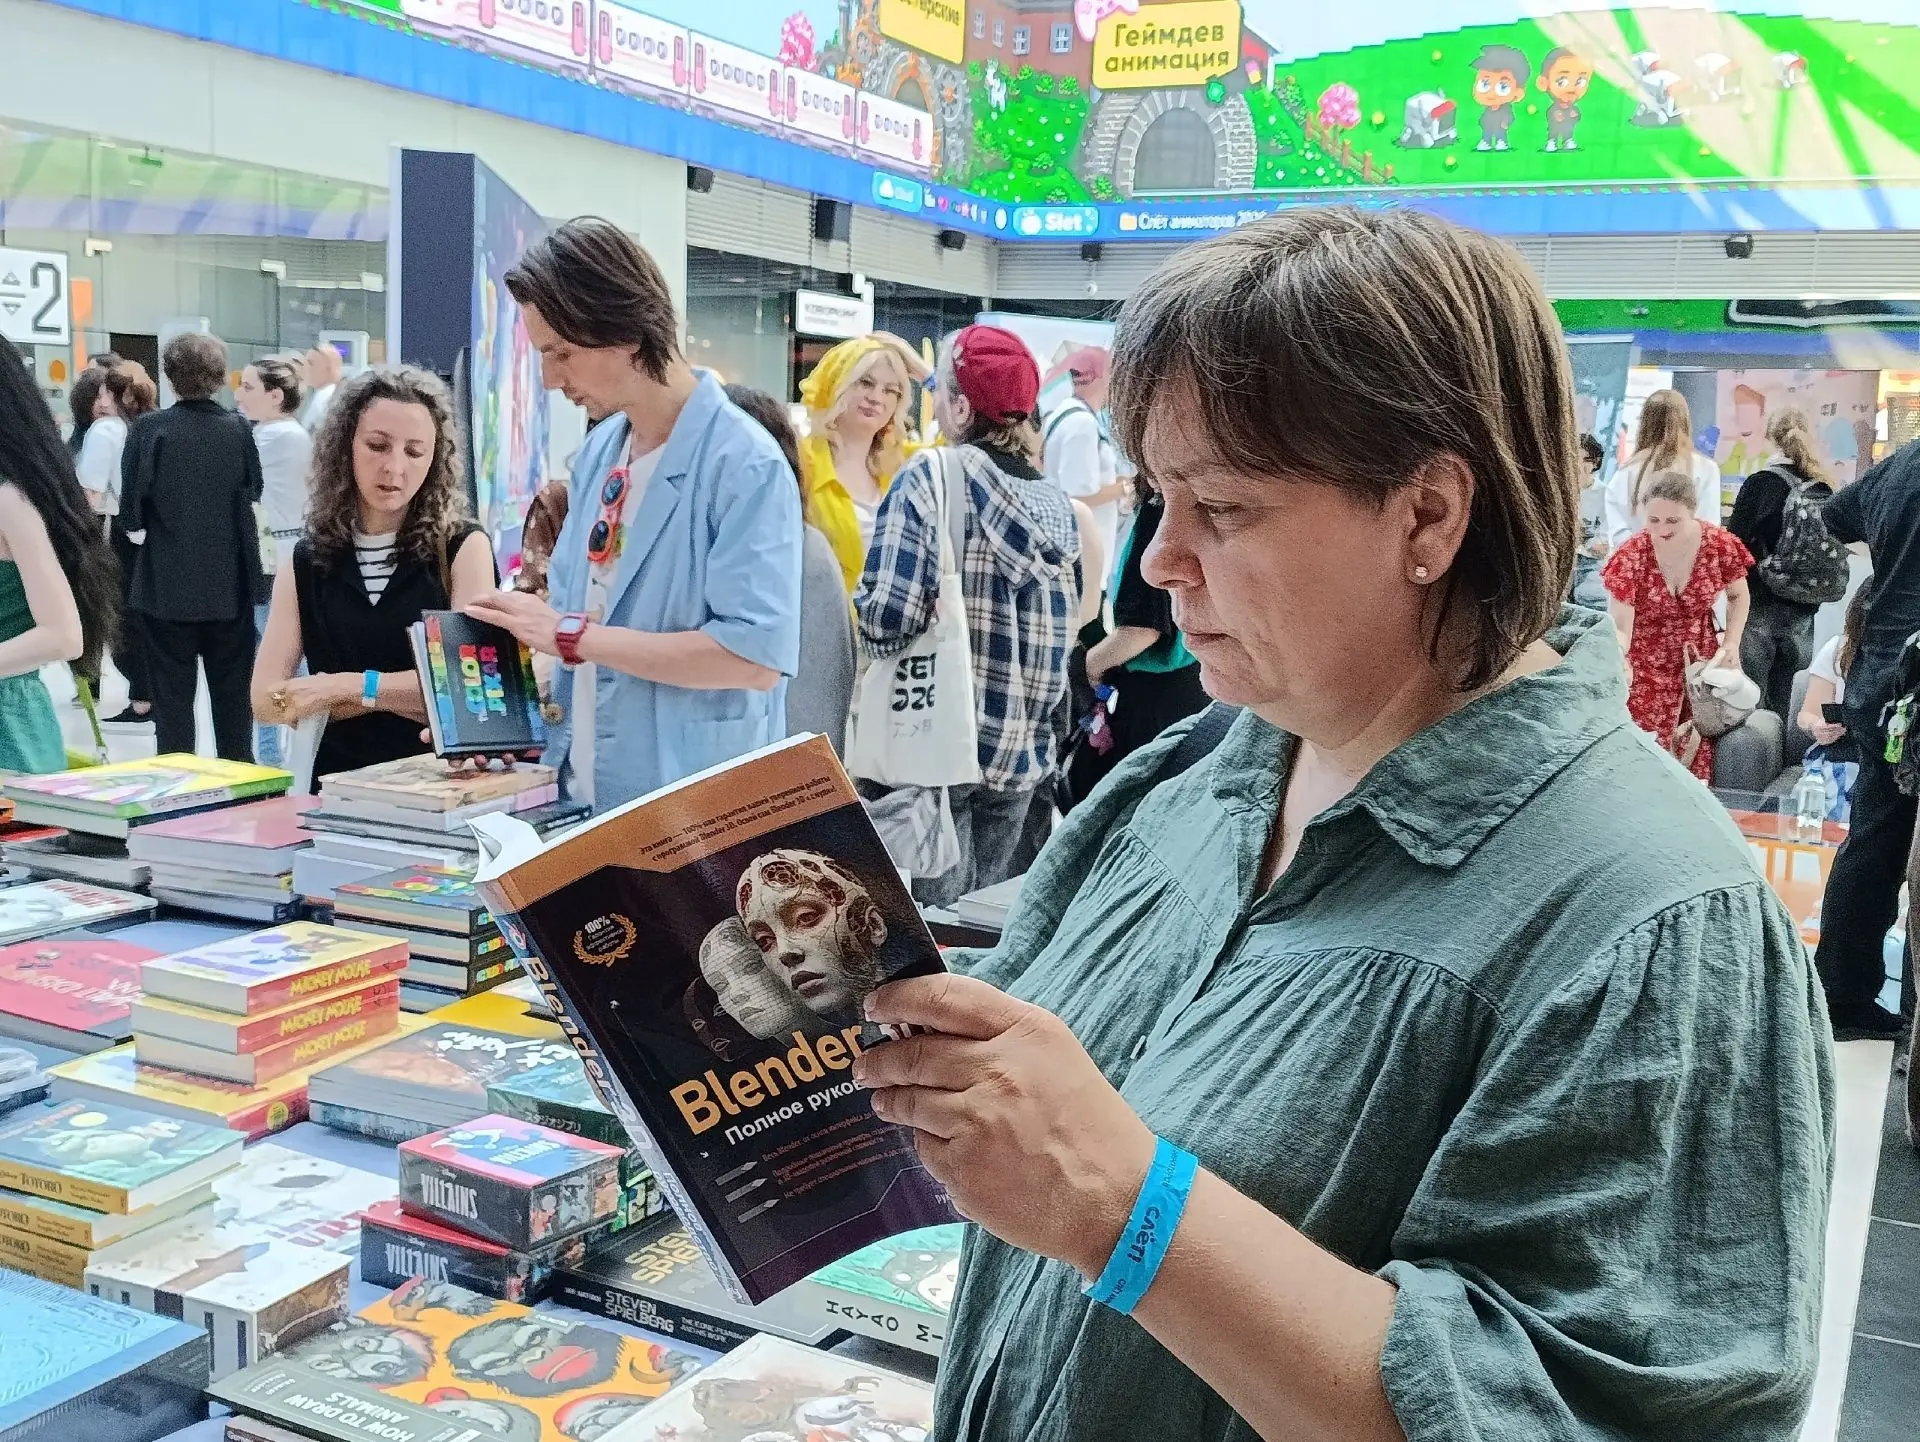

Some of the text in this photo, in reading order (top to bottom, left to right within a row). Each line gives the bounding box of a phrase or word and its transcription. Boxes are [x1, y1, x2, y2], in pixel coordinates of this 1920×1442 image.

[1114, 22, 1226, 49] Геймдев
[1103, 50, 1231, 74] анимация
[1044, 210, 1083, 232] Slet
[30, 261, 62, 335] 2
[584, 915, 611, 934] 100%
[289, 959, 372, 998] MICKEY MOUSE
[280, 995, 363, 1037] MICKEY MOUSE
[521, 956, 615, 1096] Blender
[293, 1020, 368, 1062] MICKEY MOUSE
[669, 1024, 864, 1136] Blender
[724, 1100, 804, 1146] Полное
[420, 1173, 479, 1220] VILLAINS
[385, 1243, 449, 1284] VILLAINS
[605, 1290, 657, 1316] STEVEN
[605, 1302, 675, 1334] SPIELBERG
[826, 1299, 899, 1332] HAYAO
[284, 1393, 344, 1422] DRAW
[323, 1391, 410, 1424] ANIMALS
[338, 1405, 367, 1429] TO
[365, 1420, 415, 1442] HOW
